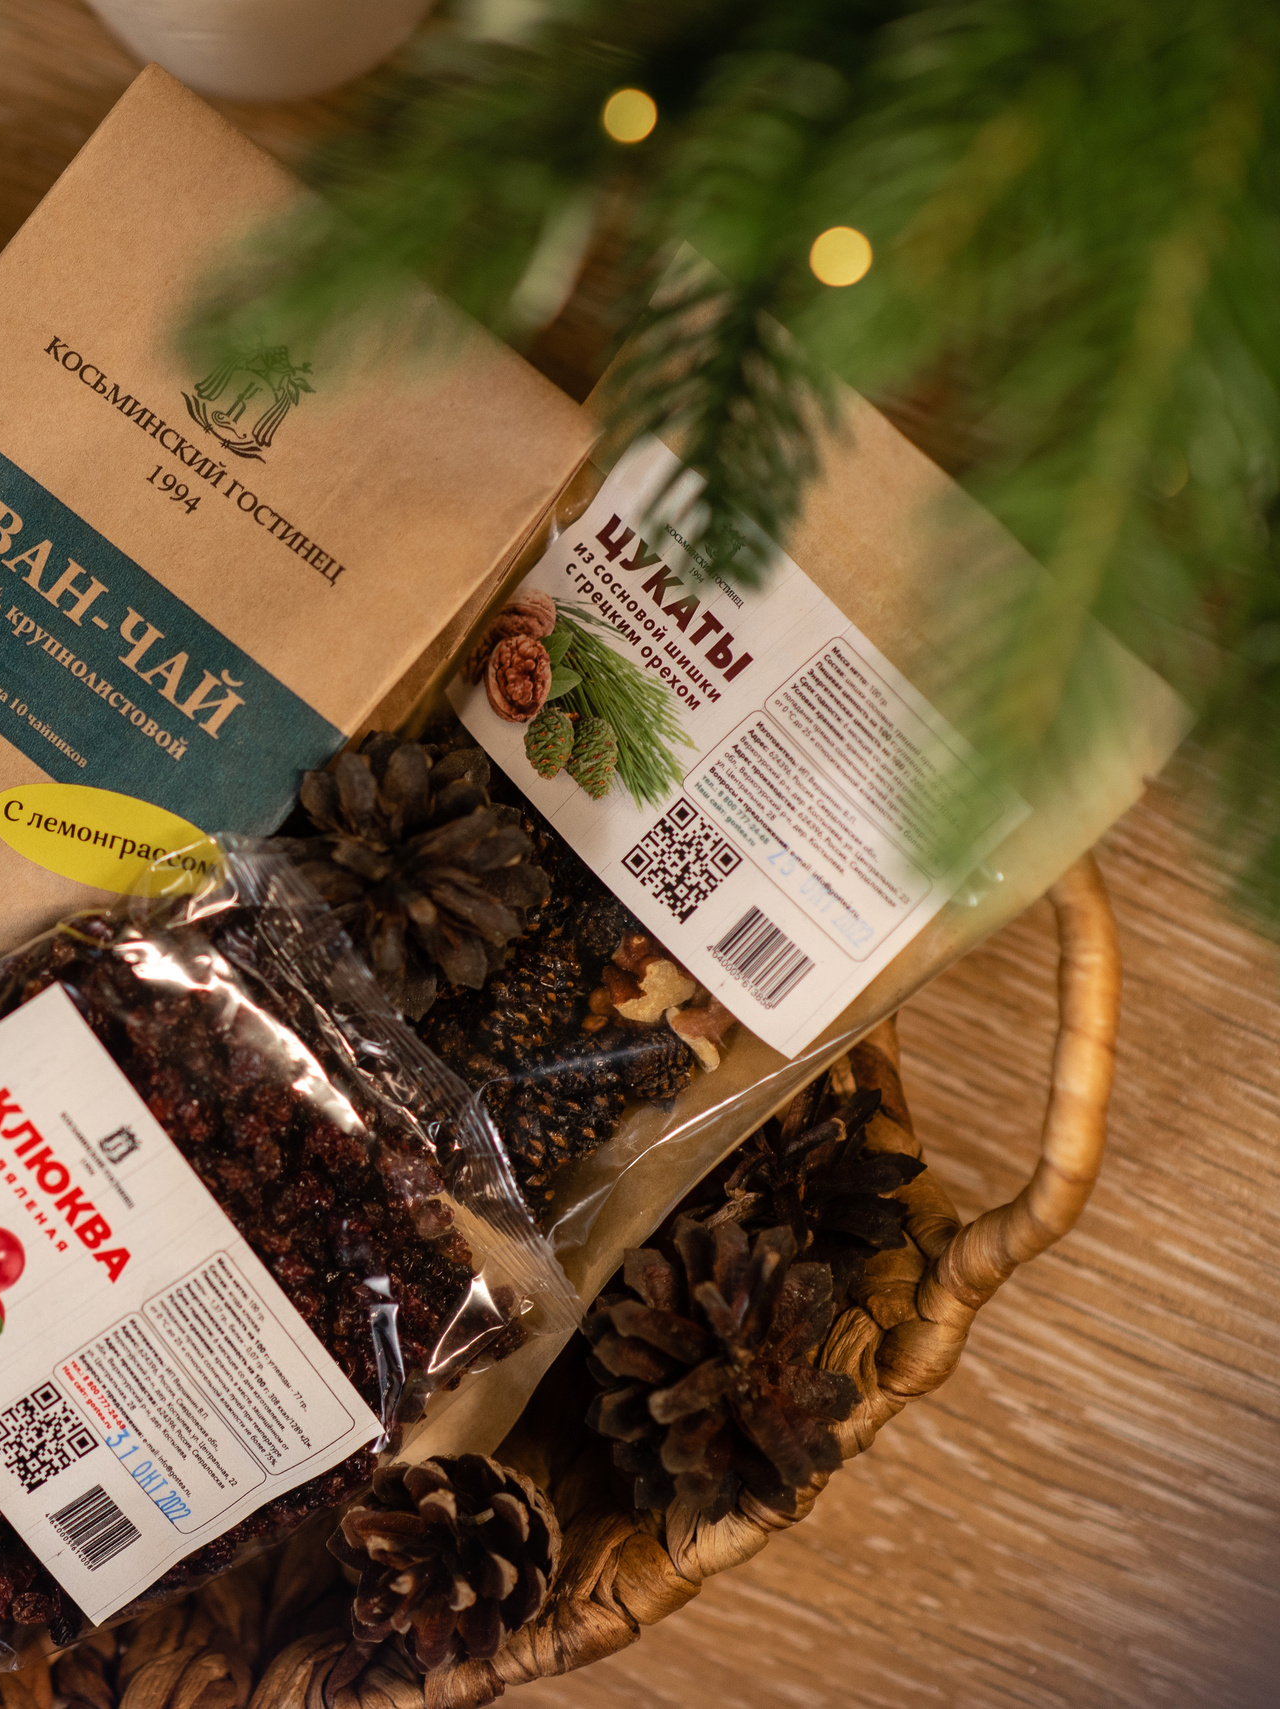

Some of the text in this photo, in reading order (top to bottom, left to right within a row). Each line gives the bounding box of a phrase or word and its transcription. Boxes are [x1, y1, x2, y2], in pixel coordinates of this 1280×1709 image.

[41, 334, 346, 588] КОСЬМИНСКИЙ ГОСТИНЕЦ
[142, 461, 205, 517] 1994
[590, 512, 754, 683] ЦУКАТЫ
[687, 566, 705, 585] 1994
[563, 561, 701, 715] с грецким орехом
[572, 541, 722, 704] из сосновой шишки
[0, 604, 192, 763] крупнолистовой
[7, 697, 29, 718] 10
[23, 711, 91, 769] чайников
[730, 742, 754, 767] Адрес
[745, 727, 771, 753] Адрес:
[707, 766, 739, 799] Вопросы
[1, 797, 25, 823] С
[710, 949, 743, 981] 640005
[740, 978, 773, 1011] 613858
[253, 1339, 266, 1353] 100
[266, 1359, 292, 1390] углеводы
[292, 1390, 303, 1401] 77
[61, 1365, 113, 1431] Наш сайт: gostea.ru
[86, 1380, 100, 1396] 800
[96, 1394, 126, 1430] 777-24-68
[174, 1396, 210, 1439] Свердловская
[253, 1373, 266, 1387] 100
[267, 1392, 280, 1406] 308
[298, 1433, 314, 1450] кДж.
[160, 1427, 189, 1461] Костылева,
[174, 1428, 193, 1451] Россия,
[190, 1448, 226, 1491] Свердловская
[241, 1408, 254, 1422] при
[250, 1420, 282, 1459] температуре
[244, 1427, 252, 1436] не
[250, 1434, 267, 1454] более
[280, 1442, 289, 1451] от
[142, 1435, 161, 1458] e-mail:
[155, 1454, 193, 1499] info@gostea.ru,
[196, 1440, 231, 1480] Центральная,
[228, 1477, 237, 1487] 22
[154, 1487, 192, 1527] 2022
